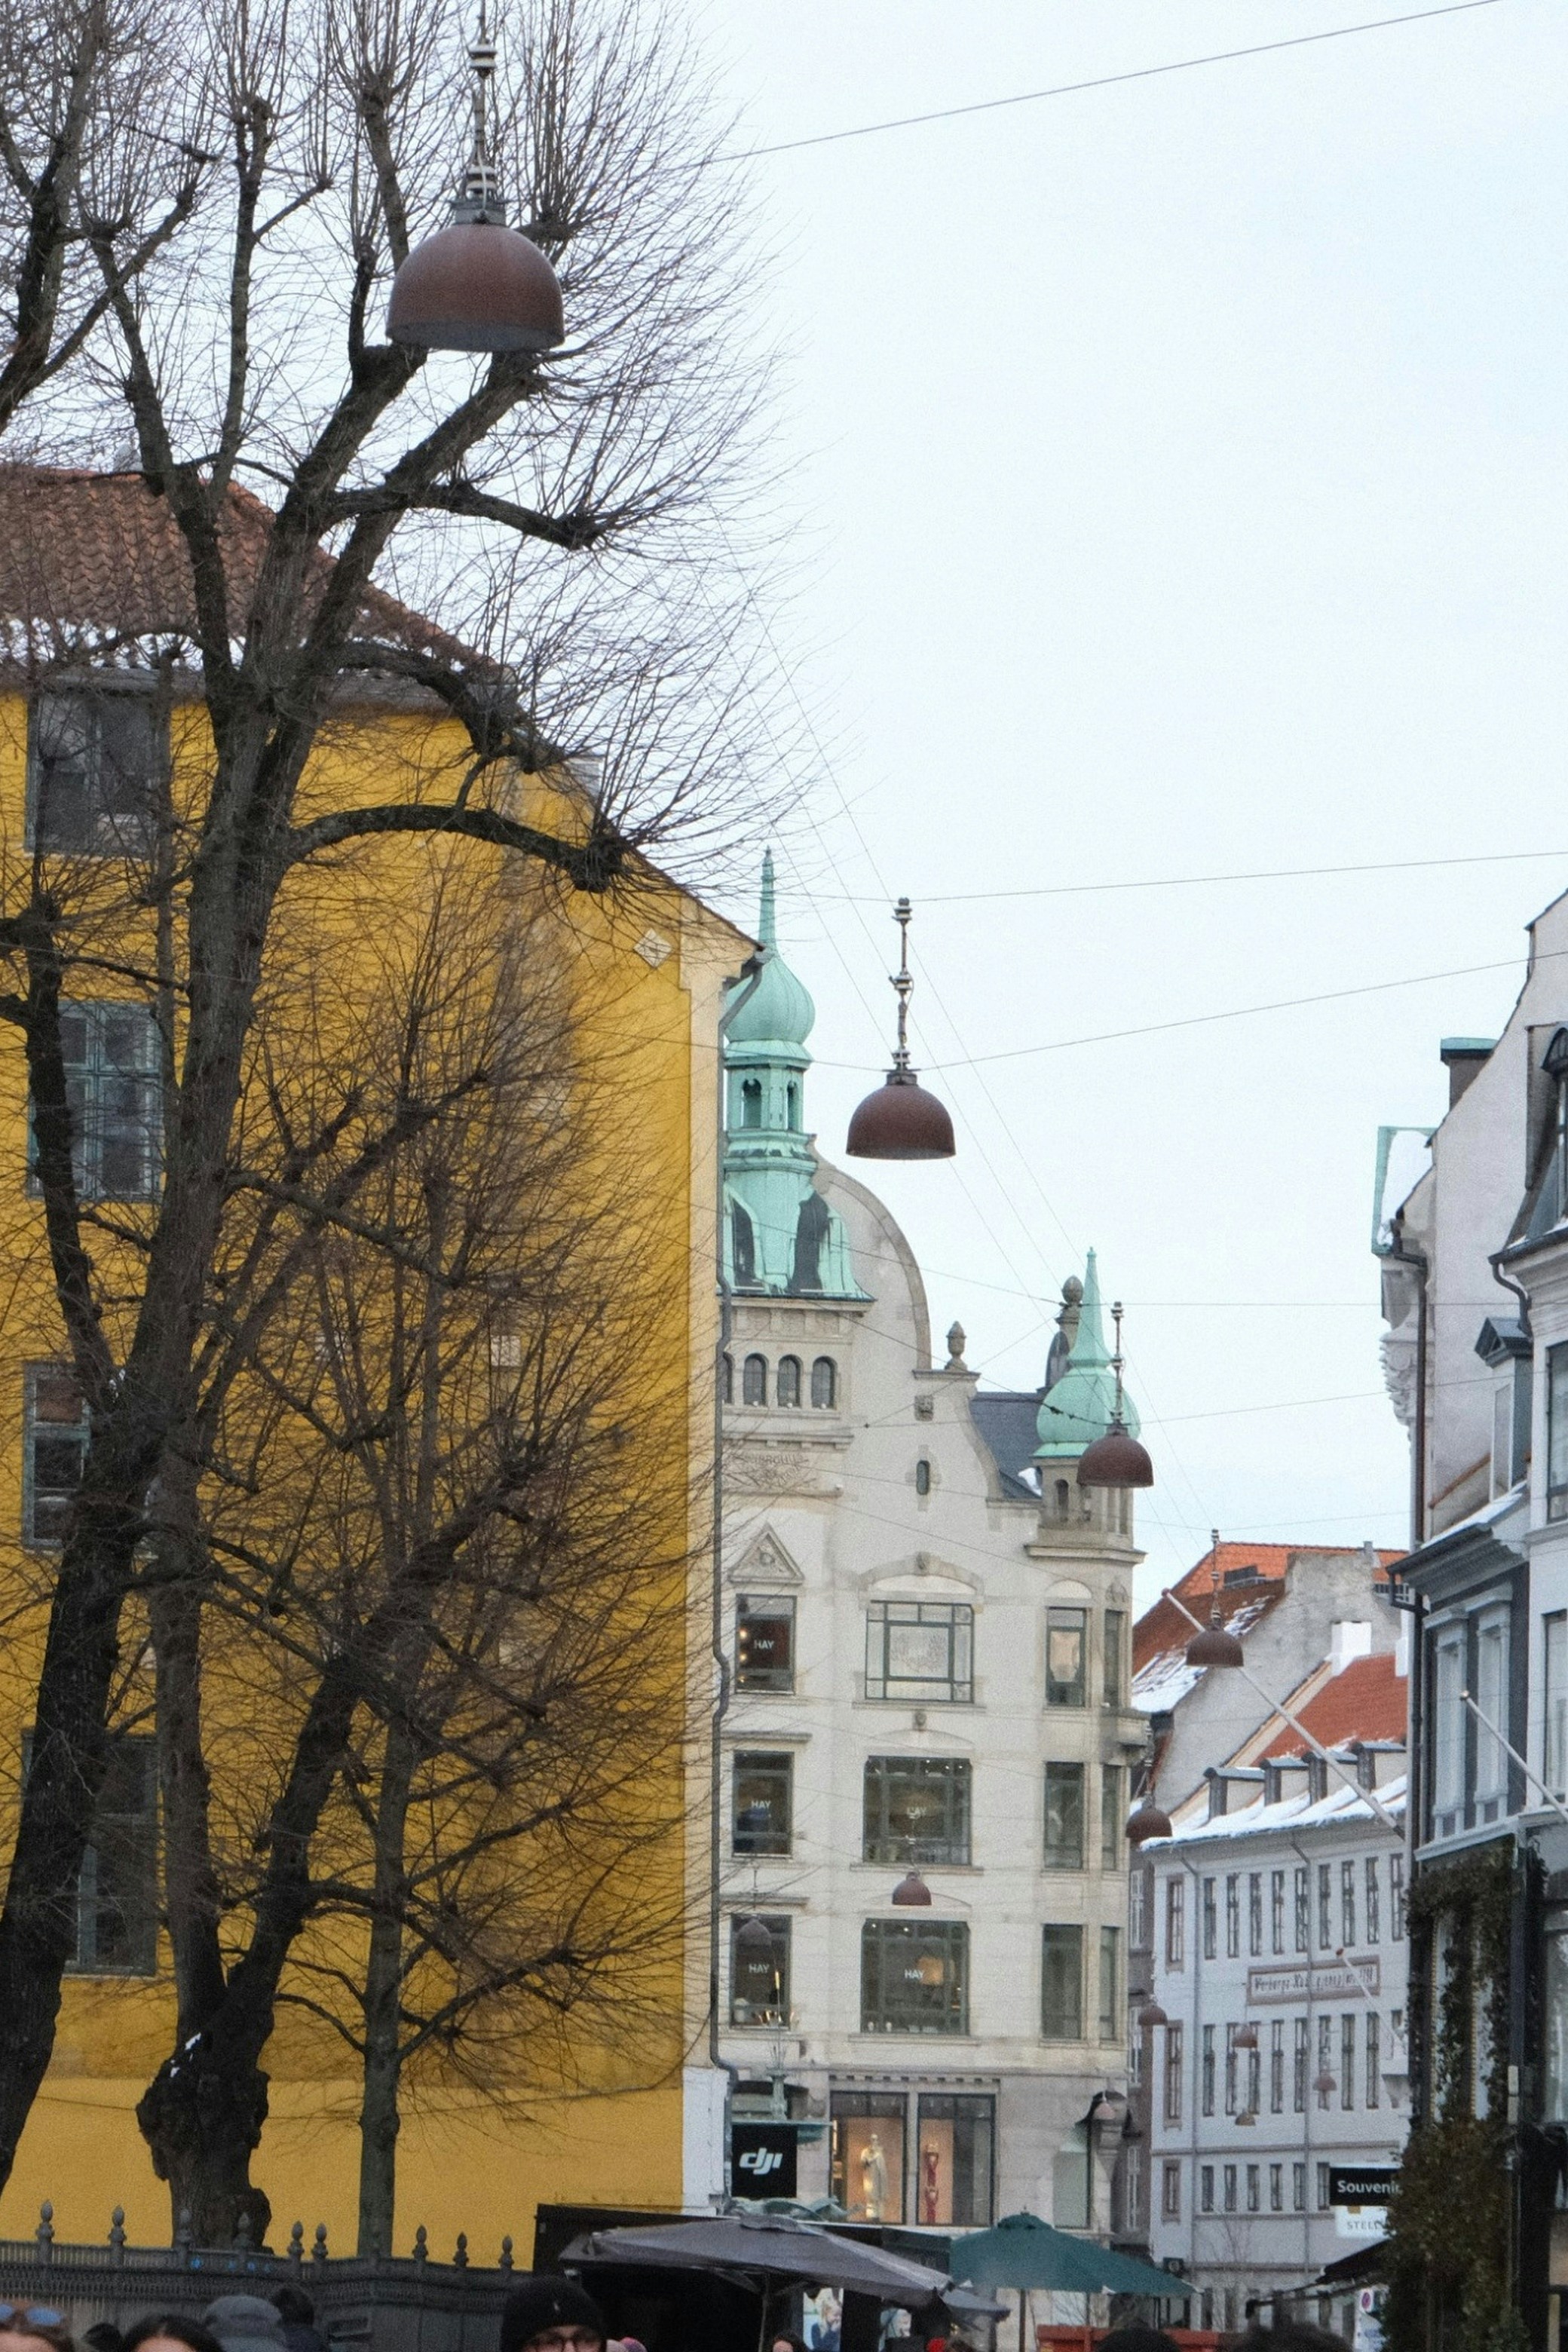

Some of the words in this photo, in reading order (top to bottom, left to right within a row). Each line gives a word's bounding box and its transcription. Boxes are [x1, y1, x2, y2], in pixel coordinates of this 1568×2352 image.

[754, 1640, 774, 1649] HAY
[751, 1800, 770, 1808] HAY
[749, 1964, 769, 1973] HAY
[905, 1969, 925, 1979] HAY
